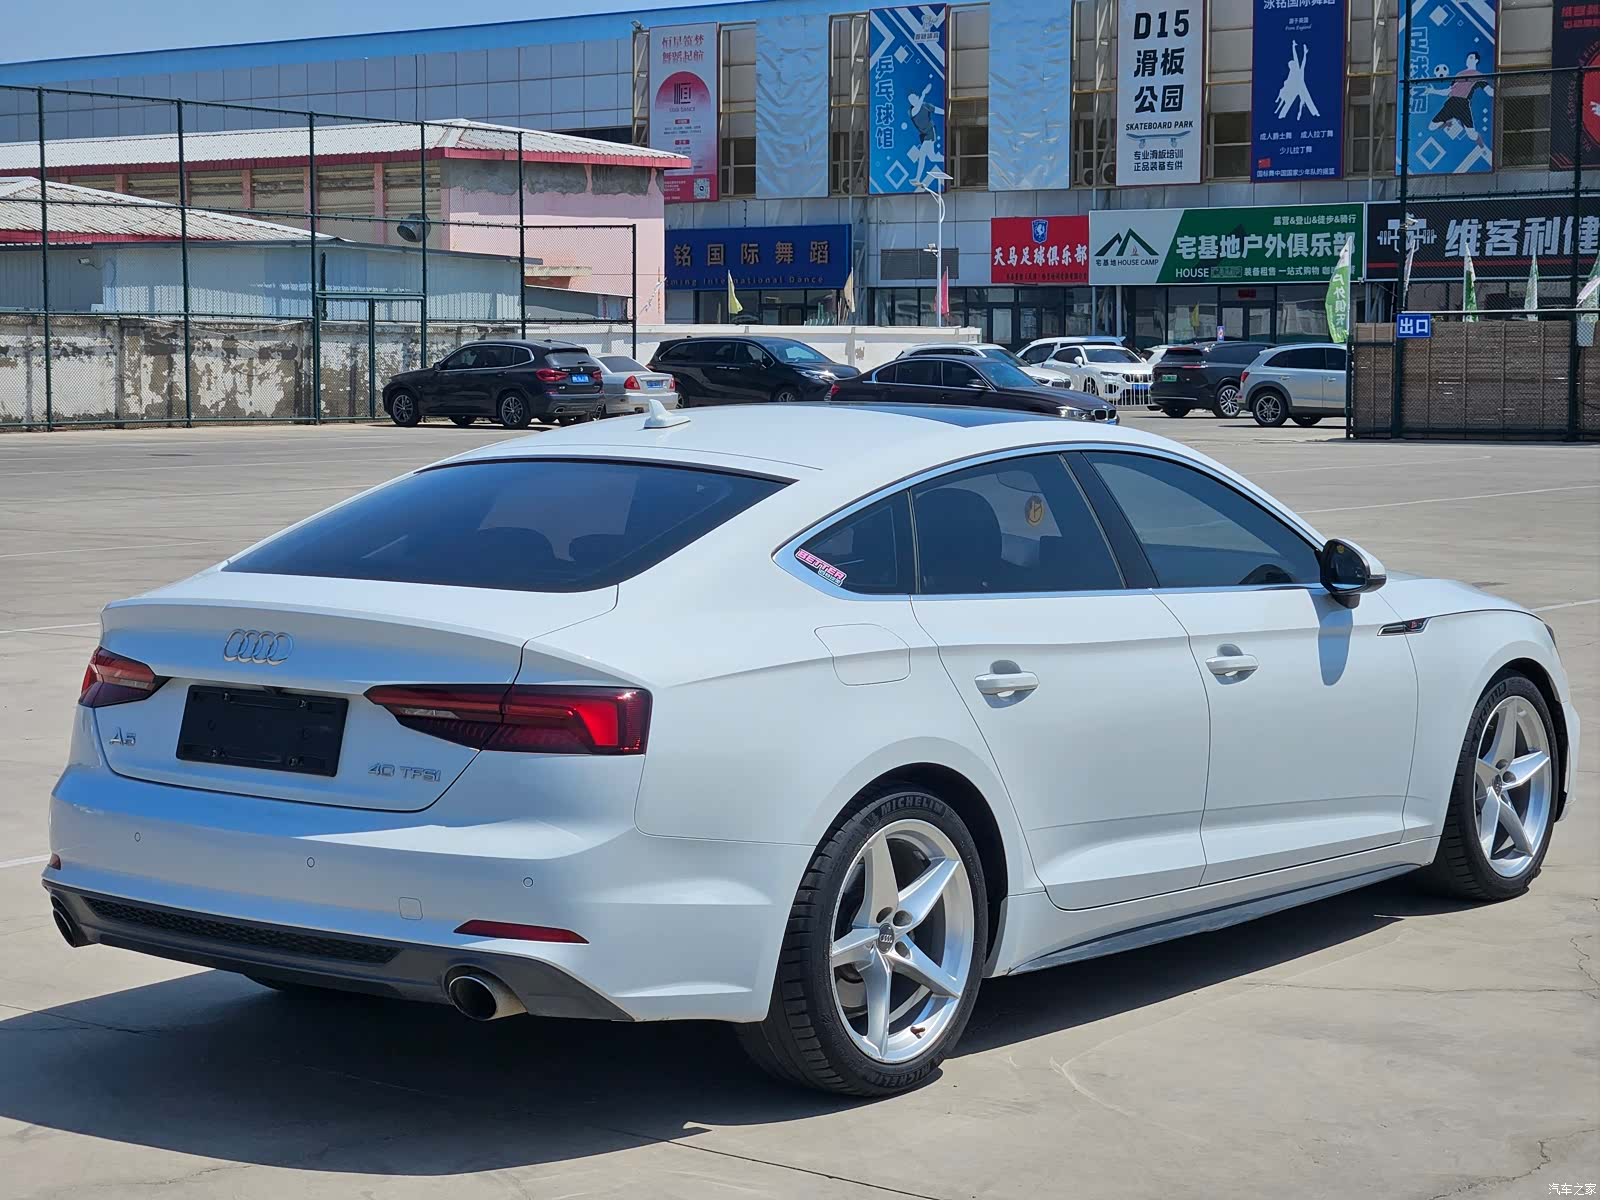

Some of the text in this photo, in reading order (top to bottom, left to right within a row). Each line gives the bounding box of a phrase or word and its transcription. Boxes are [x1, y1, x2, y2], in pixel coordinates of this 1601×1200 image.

[1134, 10, 1190, 40] D15
[1134, 47, 1185, 78] 滑板
[875, 54, 895, 150] 乒乓球馆
[1134, 84, 1185, 114] 公园
[1125, 120, 1194, 131] SKATEBOARD PARK
[1134, 149, 1184, 160] 专业滑板培训
[1134, 161, 1184, 172] 正品装备专供
[673, 240, 829, 268] 铭国际舞蹈
[993, 243, 1088, 267] 天马足球俱乐部
[1175, 231, 1356, 260] 宅基地户外俱乐部
[704, 277, 782, 286] Intenational
[789, 276, 824, 284] Dance
[1175, 268, 1209, 278] HOUSE
[1243, 266, 1276, 277] 装备租售
[1279, 265, 1320, 276] 一站式购物
[1400, 317, 1429, 335] 出口
[796, 549, 845, 581] BETTER
[109, 727, 136, 746] A5
[368, 763, 395, 777] 40
[881, 796, 943, 816] MICHELIN
